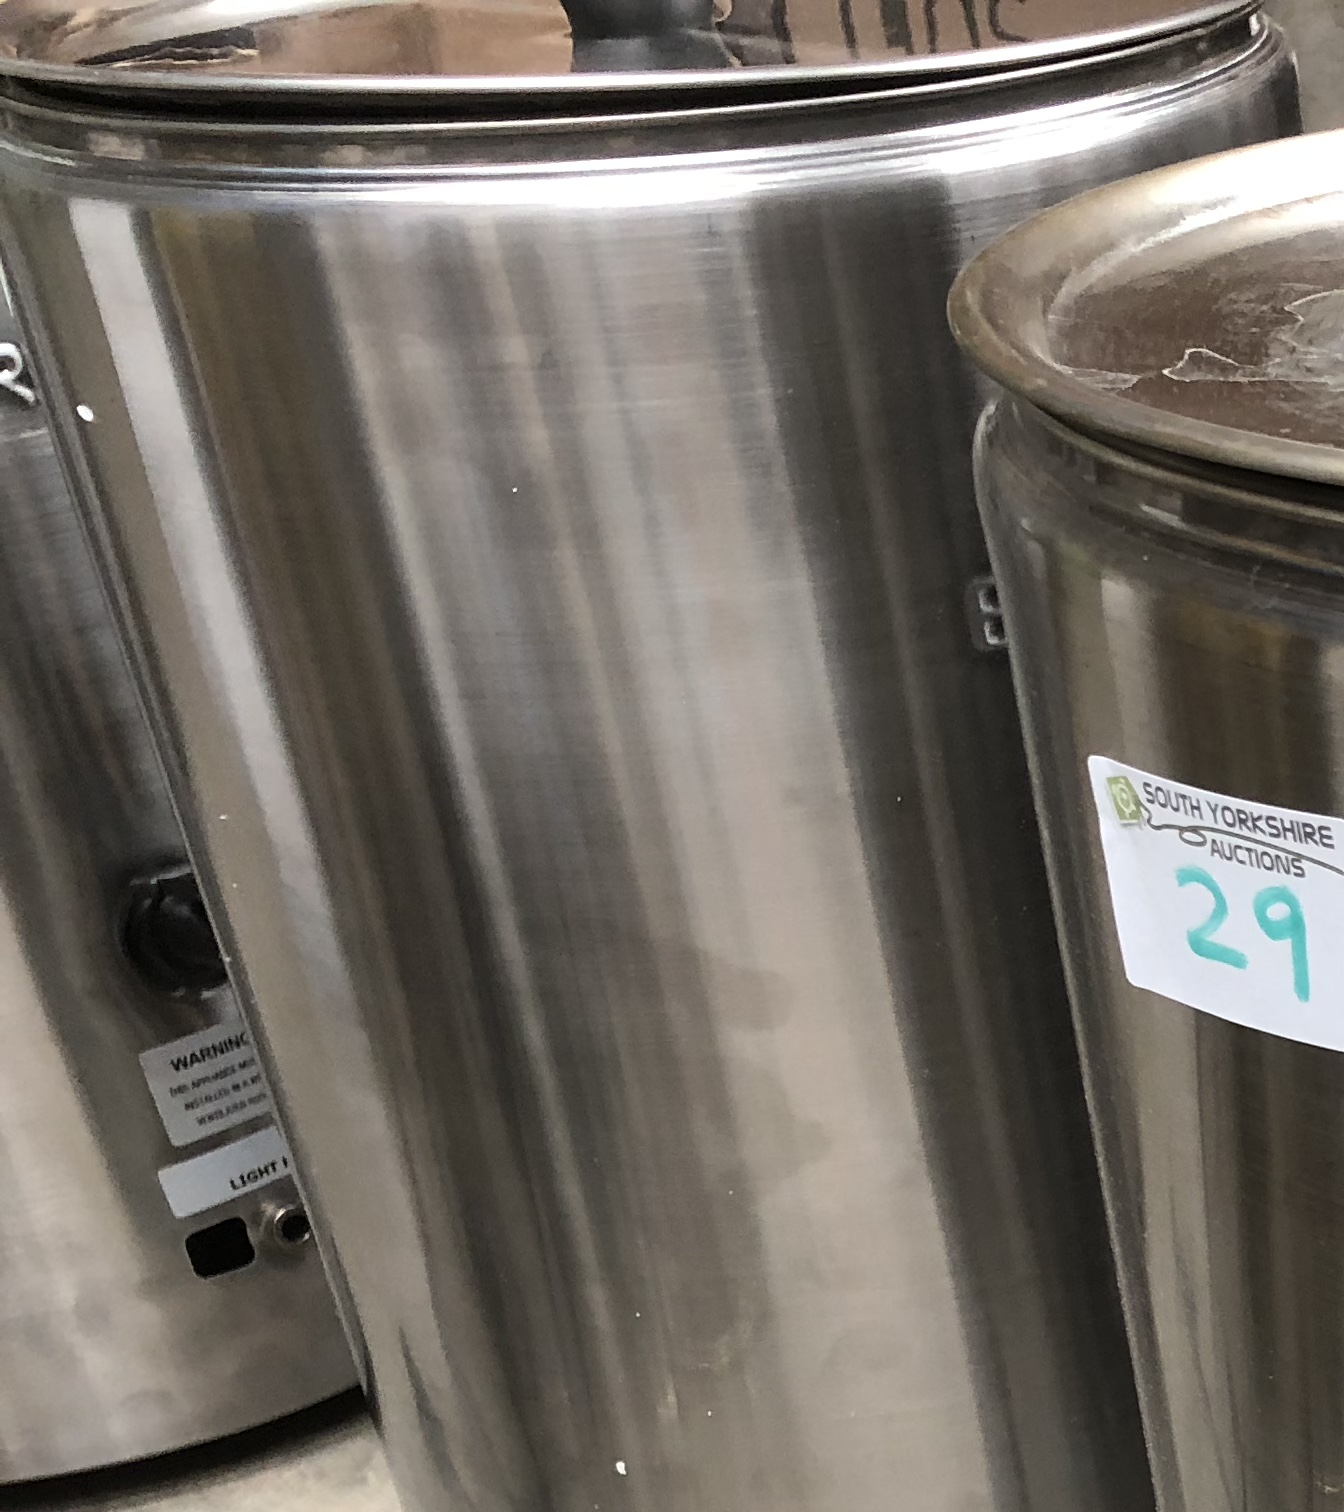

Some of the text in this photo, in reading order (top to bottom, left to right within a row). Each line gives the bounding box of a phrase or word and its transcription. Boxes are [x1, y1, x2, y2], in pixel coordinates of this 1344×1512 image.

[1143, 781, 1336, 850] SOUTH YORKSHIRE
[1210, 838, 1307, 878] AUCTIONS
[1175, 865, 1310, 1003] 29
[229, 1160, 277, 1190] LIGHT
